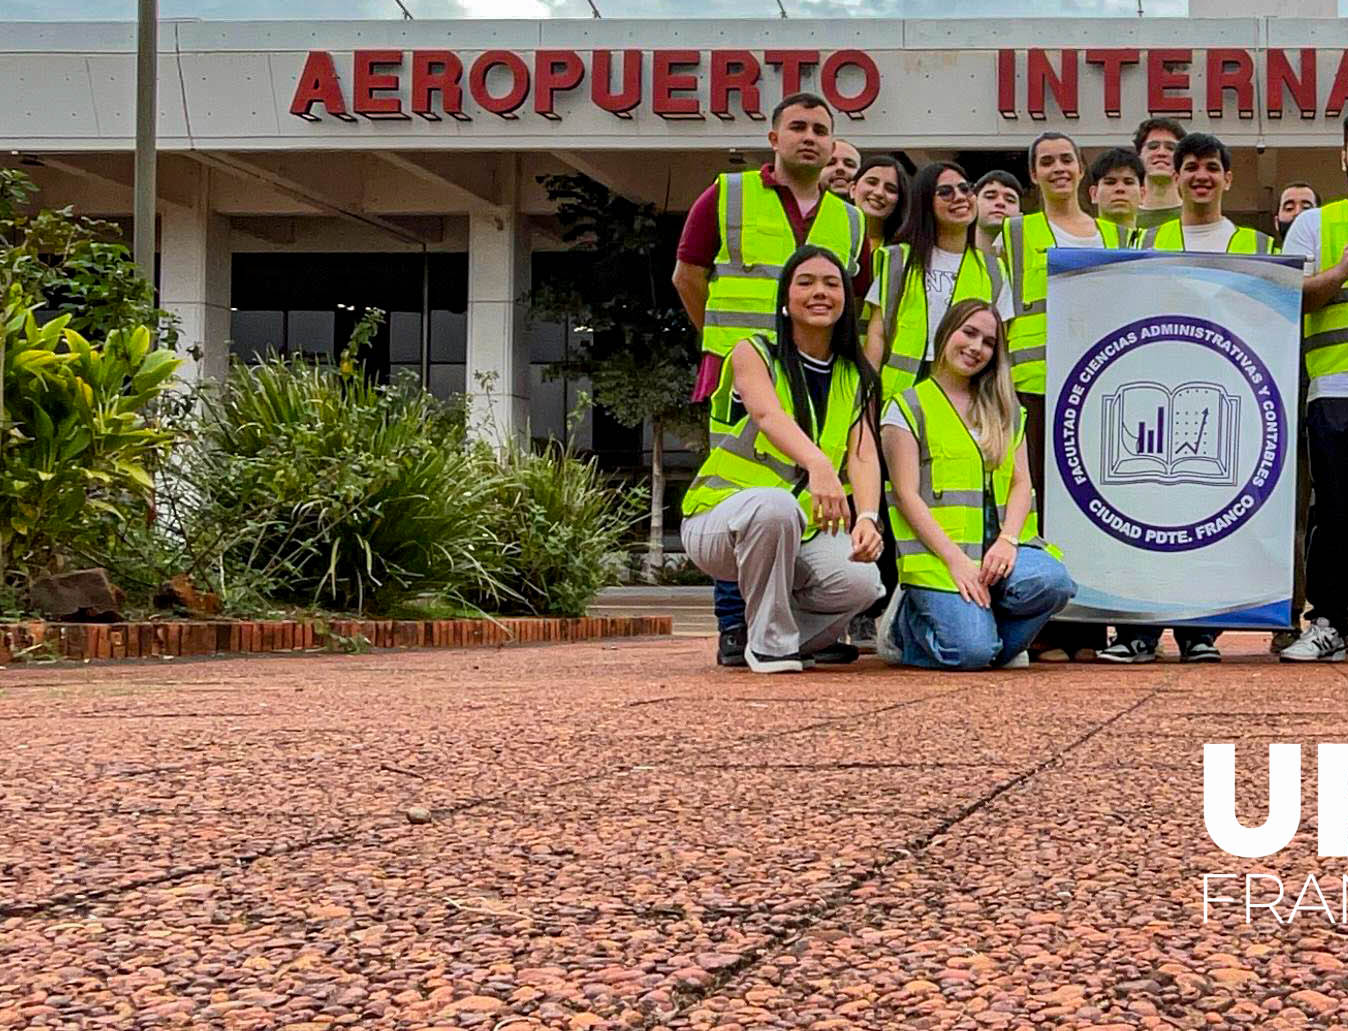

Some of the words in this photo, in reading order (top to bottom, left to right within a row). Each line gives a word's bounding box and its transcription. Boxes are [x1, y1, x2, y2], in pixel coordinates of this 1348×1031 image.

[289, 49, 881, 119] AEROPUERTO
[1081, 332, 1137, 383] CIENCIAS
[1140, 323, 1264, 383] ADMINISTRATIVAS
[1069, 384, 1085, 405] DE
[1258, 385, 1271, 396] Y
[1063, 408, 1087, 485] FACULTAD
[1252, 400, 1278, 488] CONTABLES
[1088, 498, 1142, 539] CIUDAD
[1145, 529, 1193, 545] PDTE.
[1196, 494, 1255, 540] FRANCO
